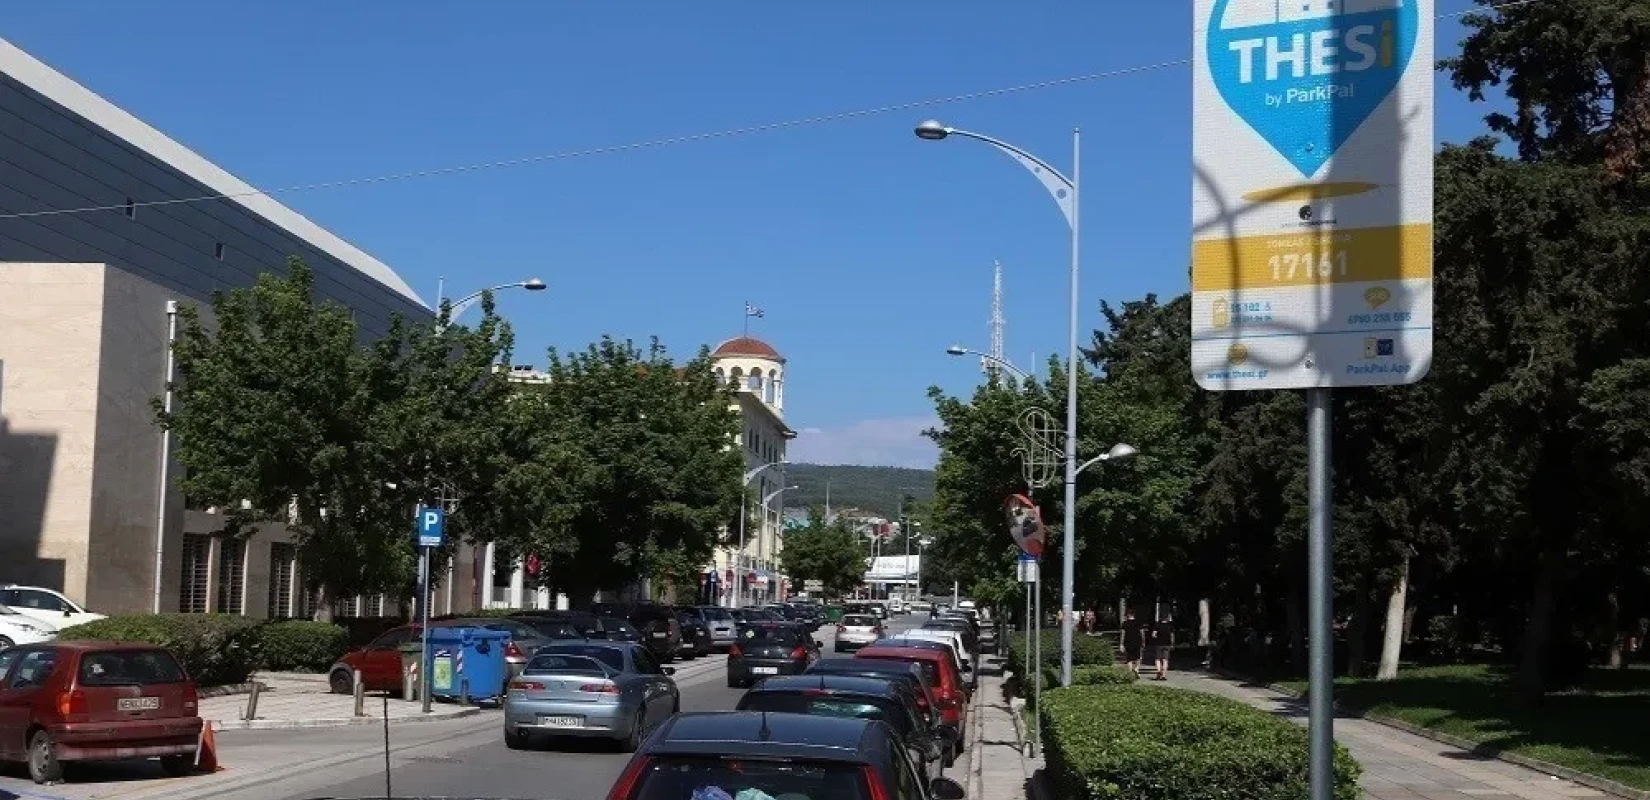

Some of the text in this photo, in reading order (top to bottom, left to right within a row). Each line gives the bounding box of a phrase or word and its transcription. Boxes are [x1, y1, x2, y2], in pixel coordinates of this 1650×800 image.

[1228, 19, 1394, 84] THESi
[1265, 83, 1354, 108] by ParkPal
[1268, 250, 1348, 281] 17161
[425, 511, 438, 531] P
